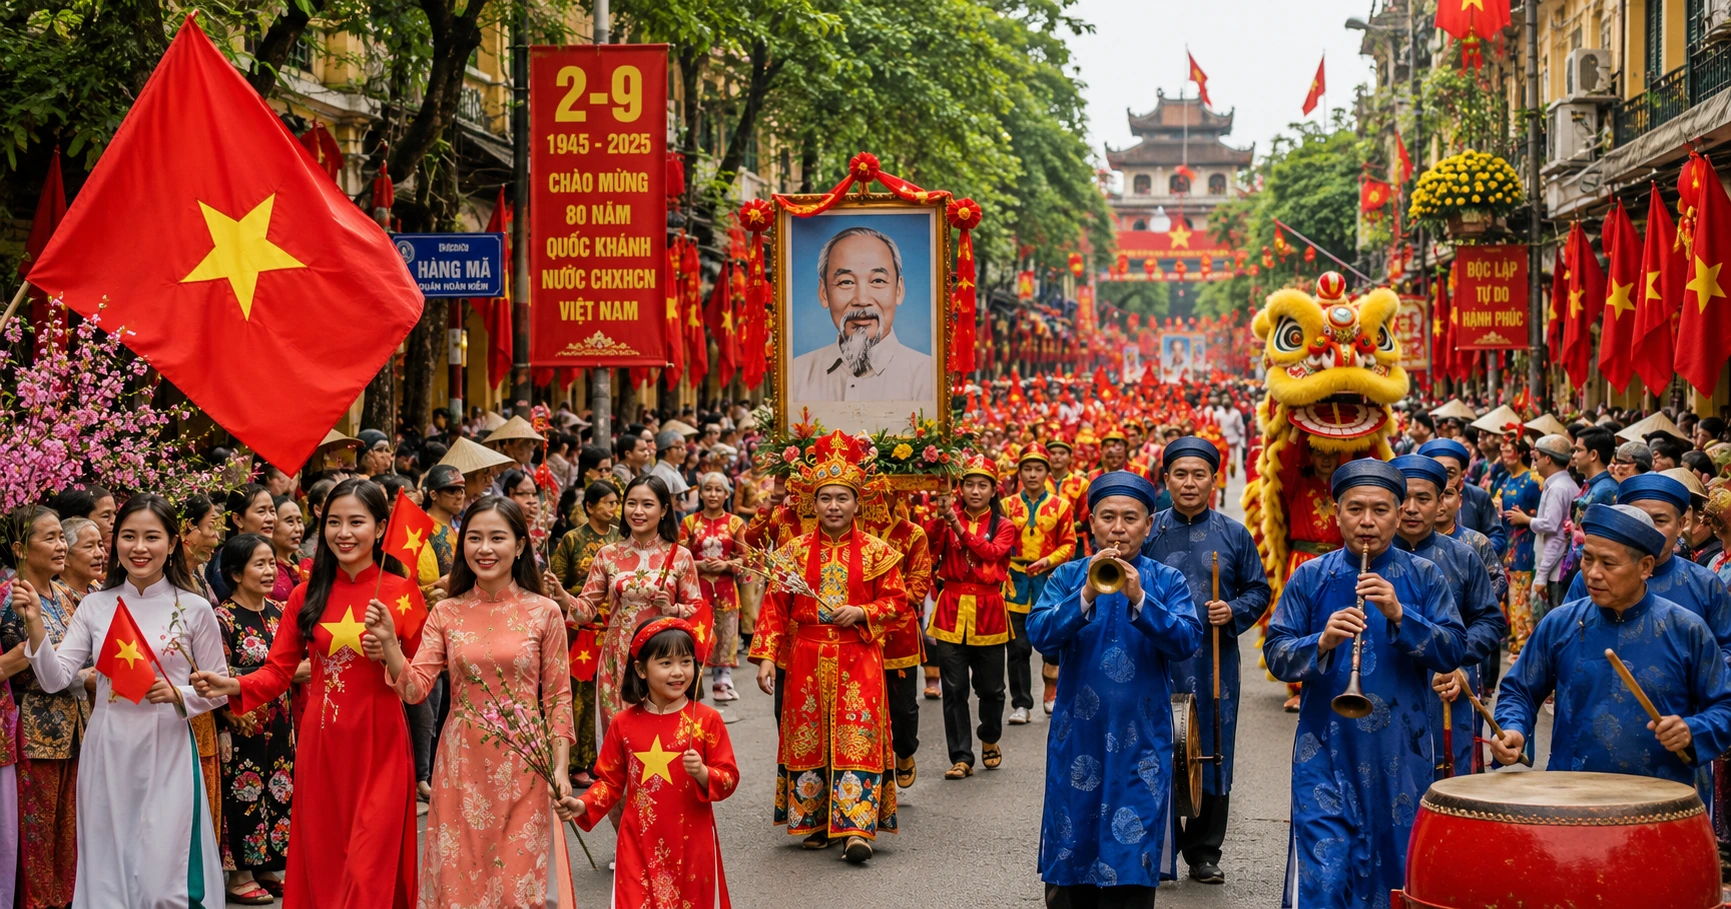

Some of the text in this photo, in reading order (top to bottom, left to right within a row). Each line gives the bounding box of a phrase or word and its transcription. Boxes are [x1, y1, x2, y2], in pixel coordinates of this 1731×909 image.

[555, 65, 643, 123] 2-9
[547, 133, 590, 155] 1945
[607, 133, 652, 155] 2025
[548, 167, 649, 194] CHÀO MỪNG
[565, 201, 631, 226] 80 NĂM
[546, 230, 652, 261] QUỐC KHÁNH
[417, 256, 461, 279] HÀNG
[590, 269, 656, 290] CHXHCN
[1475, 284, 1510, 305] TỰ DO
[559, 296, 639, 326] VIỆT NAM
